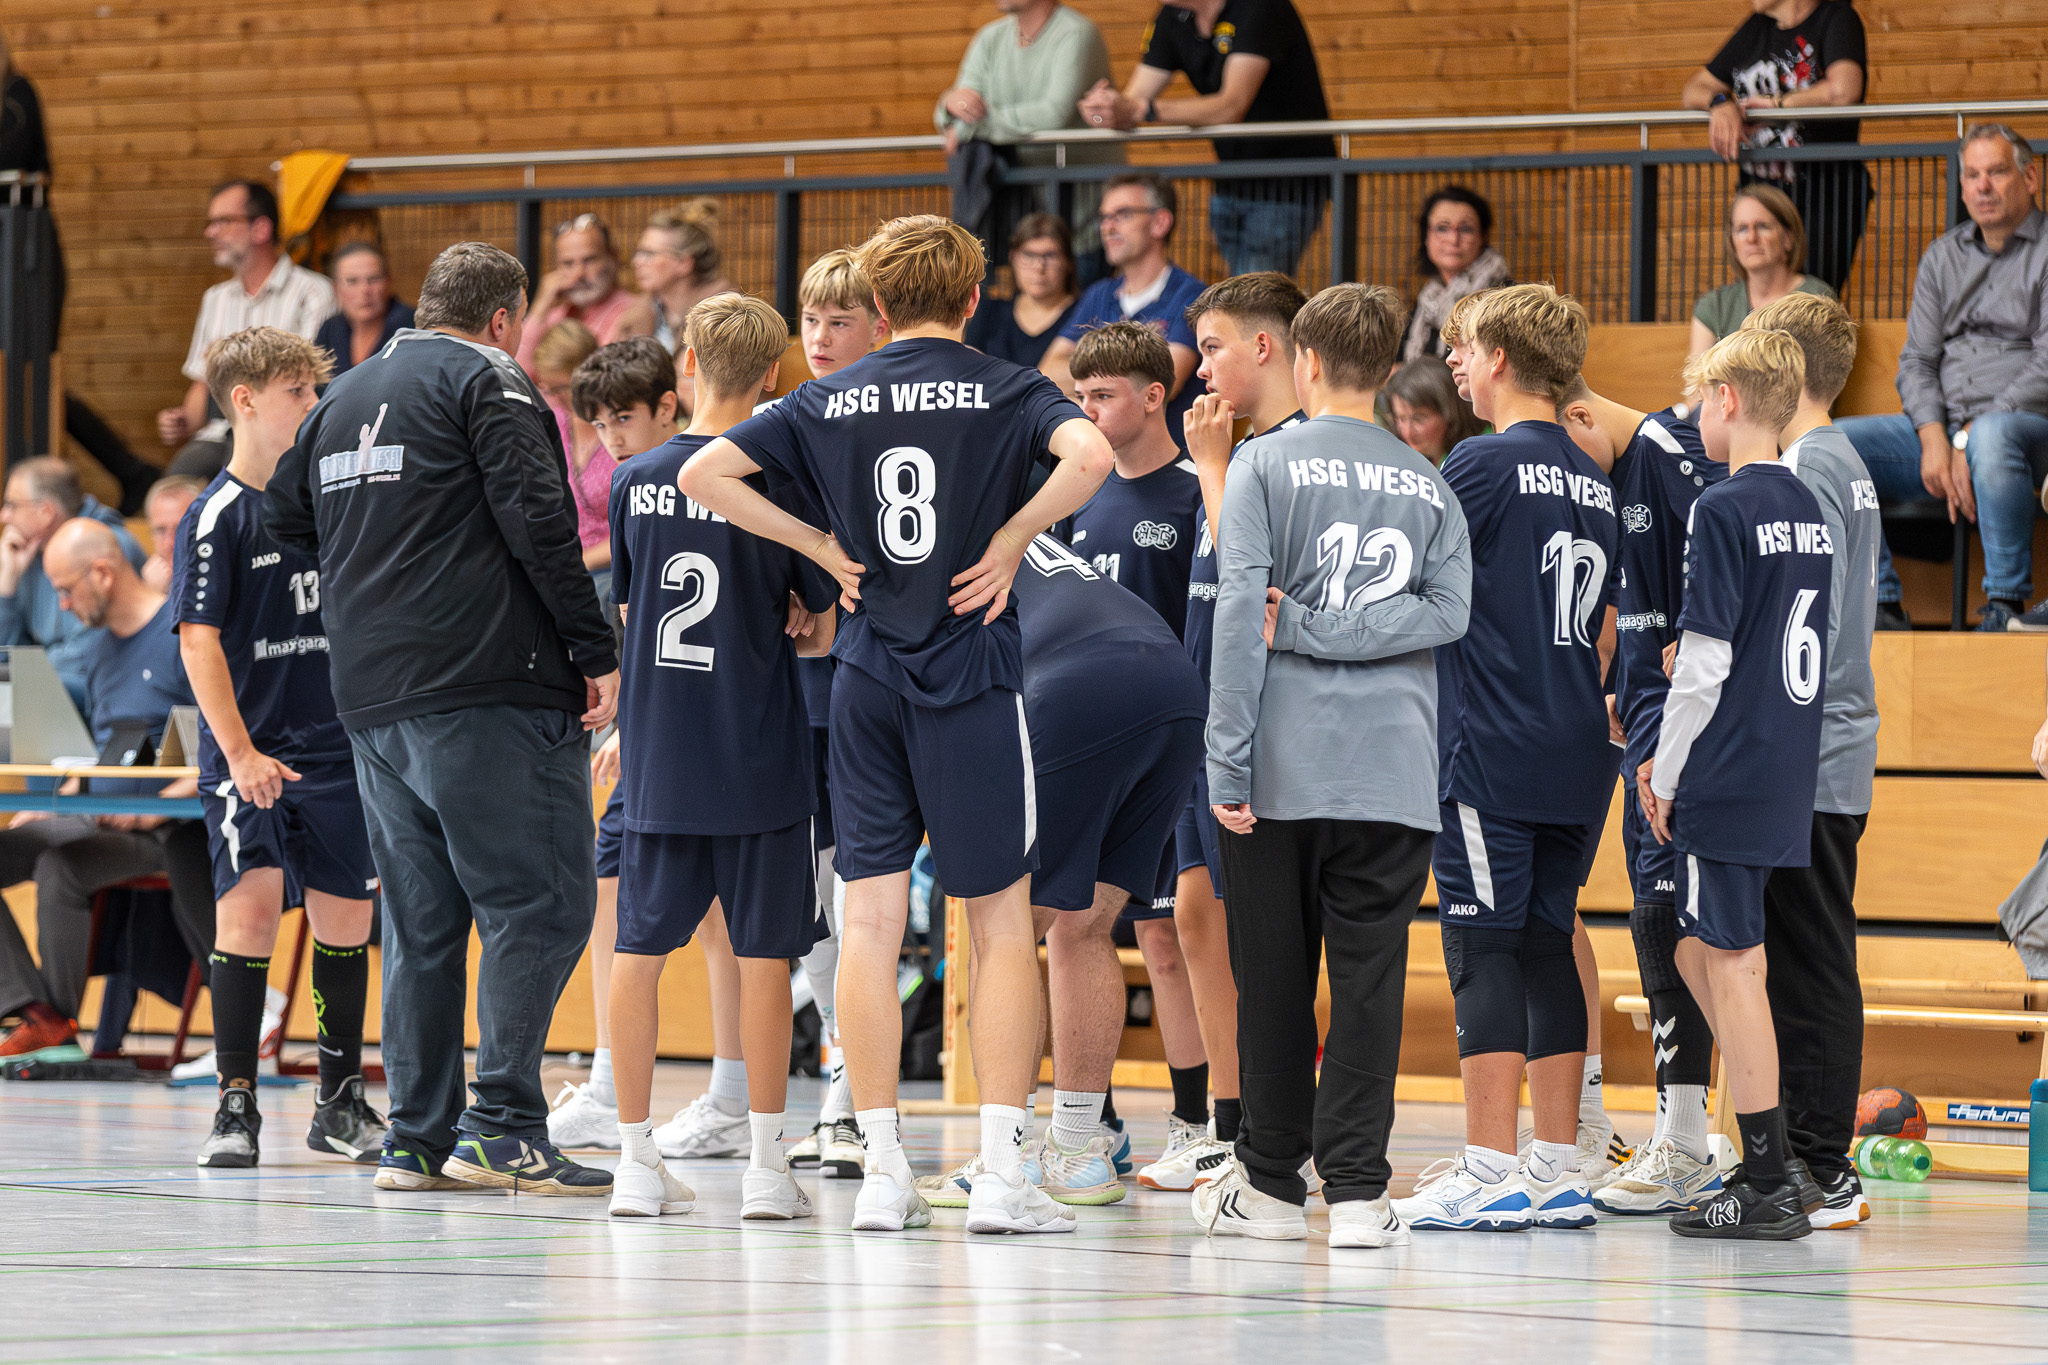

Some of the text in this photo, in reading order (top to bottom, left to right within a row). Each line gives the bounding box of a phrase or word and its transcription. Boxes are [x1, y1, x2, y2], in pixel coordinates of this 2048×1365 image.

[824, 381, 990, 419] HSG WESEL
[629, 483, 677, 517] HSG
[874, 446, 937, 565] 8
[1288, 457, 1445, 510] HSG WESEL
[1518, 463, 1616, 518] HSG WESEL
[252, 552, 281, 570] JAKO
[1092, 553, 1121, 583] 11
[1316, 521, 1414, 612] 12
[289, 570, 320, 615] 13
[655, 552, 719, 672] 2
[1782, 588, 1822, 706] 6
[1151, 896, 1177, 910] JAKO
[1447, 903, 1479, 916] JAKO
